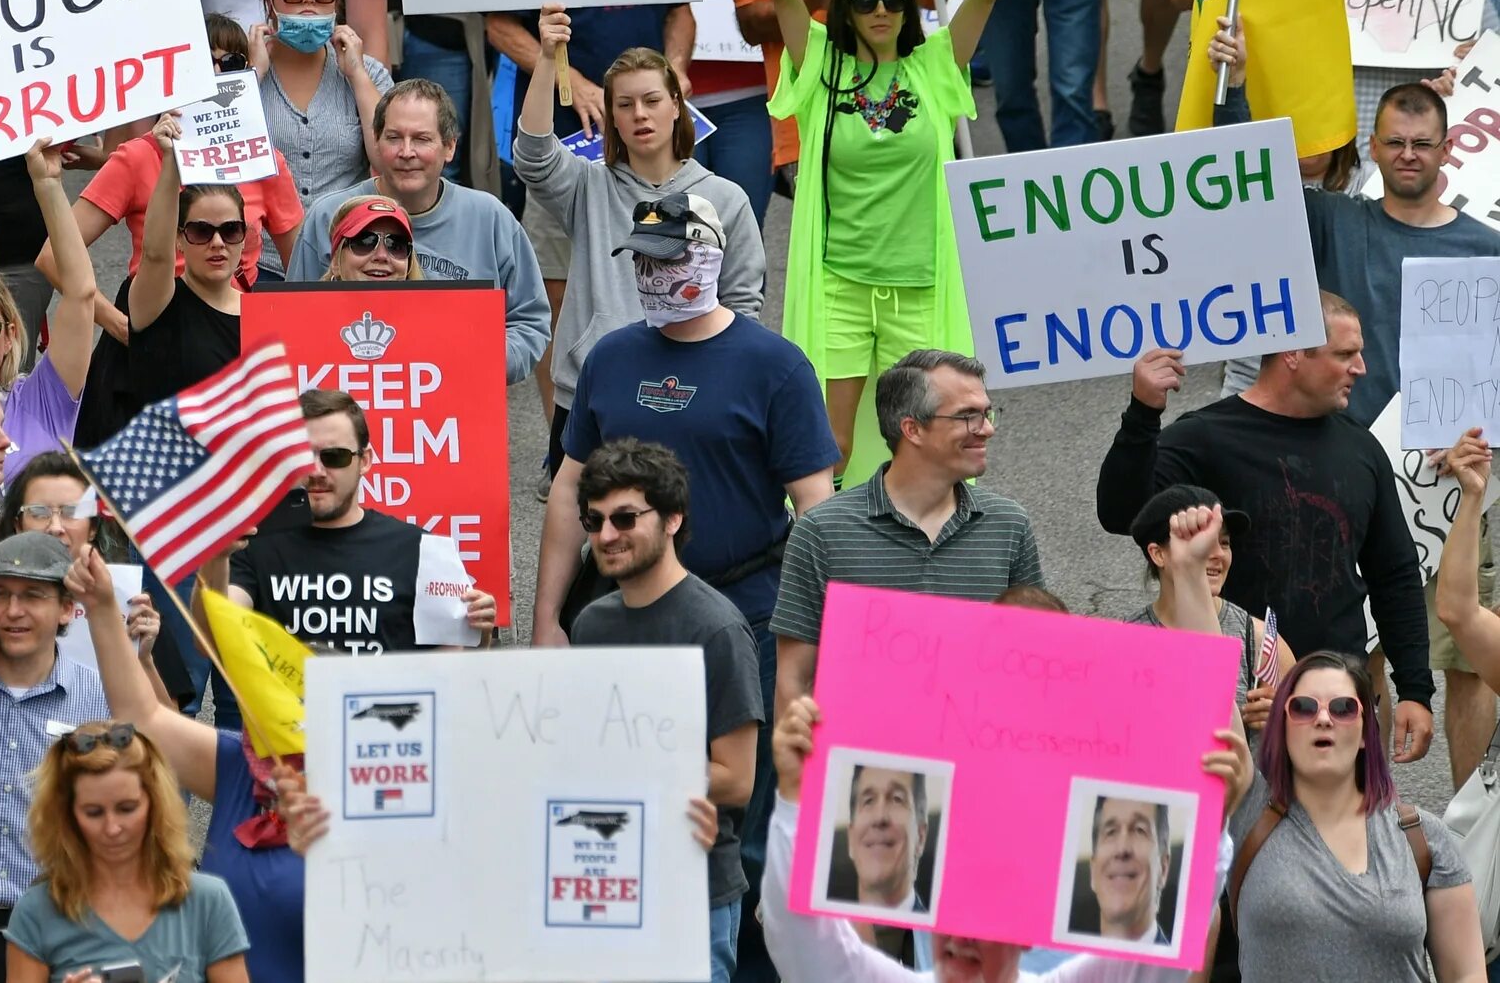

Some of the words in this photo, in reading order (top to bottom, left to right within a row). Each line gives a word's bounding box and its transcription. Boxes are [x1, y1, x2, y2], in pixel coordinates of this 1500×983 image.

[13, 35, 55, 73] IS
[193, 113, 212, 124] WE
[214, 107, 238, 121] THE
[197, 119, 240, 136] PEOPLE
[180, 136, 269, 167] FREE
[210, 134, 233, 146] ARE
[969, 146, 1276, 242] ENOUGH
[1121, 234, 1168, 275] IS
[995, 278, 1296, 374] ENOUGH
[297, 362, 443, 409] KEEP
[1407, 377, 1468, 427] END
[270, 575, 356, 602] WHO
[364, 575, 394, 601] IS
[286, 608, 378, 634] JOHN
[482, 675, 561, 745] We
[601, 684, 676, 751] Are
[356, 744, 389, 759] LET
[397, 742, 422, 757] US
[349, 764, 429, 784] WORK
[573, 841, 591, 851] WE
[594, 841, 617, 851] THE
[574, 854, 617, 864] PEOPLE
[584, 867, 608, 877] ARE
[551, 876, 638, 903] FREE
[355, 925, 487, 976] Majority
